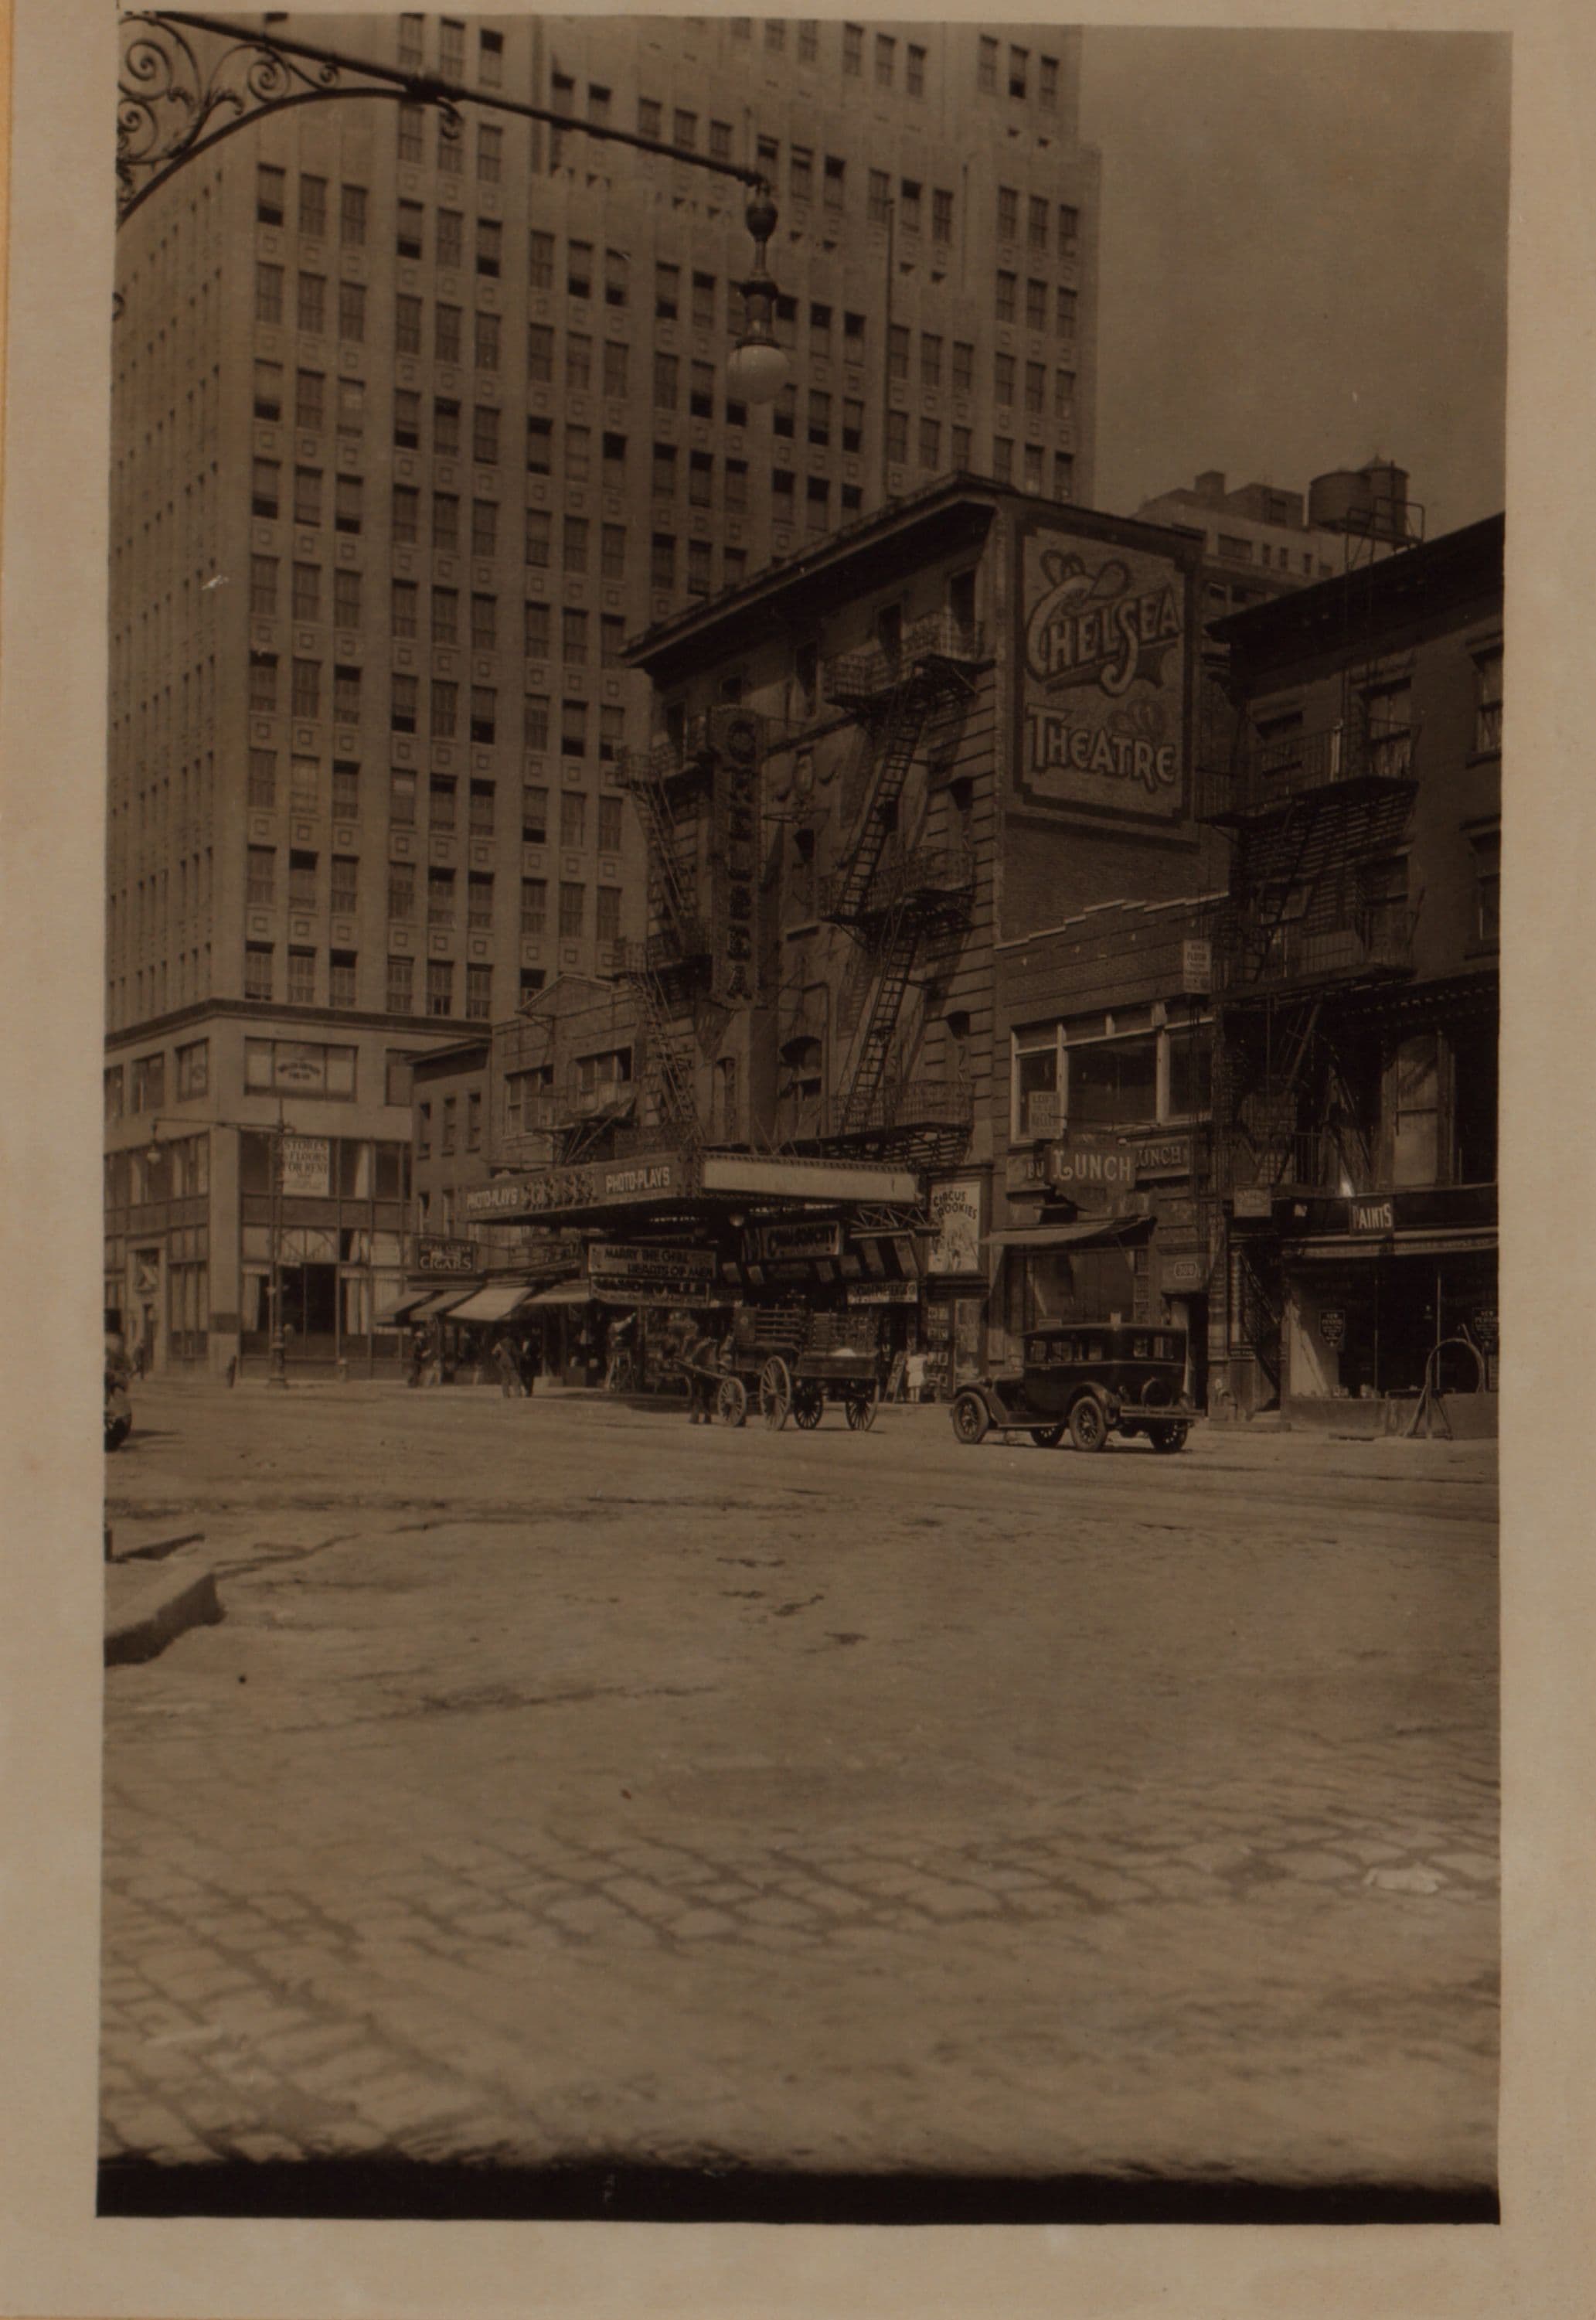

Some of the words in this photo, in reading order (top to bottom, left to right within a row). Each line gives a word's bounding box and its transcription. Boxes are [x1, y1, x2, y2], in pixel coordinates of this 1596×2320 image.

[1026, 567, 1183, 697] CHELSEA
[1026, 703, 1177, 794] THEATRE
[1052, 1149, 1131, 1182] LUNCH
[933, 1191, 966, 1207] CIRCUS
[938, 1202, 977, 1220] ROOKIES
[1353, 1203, 1391, 1230] PAINTS
[420, 1255, 471, 1269] CIGARS
